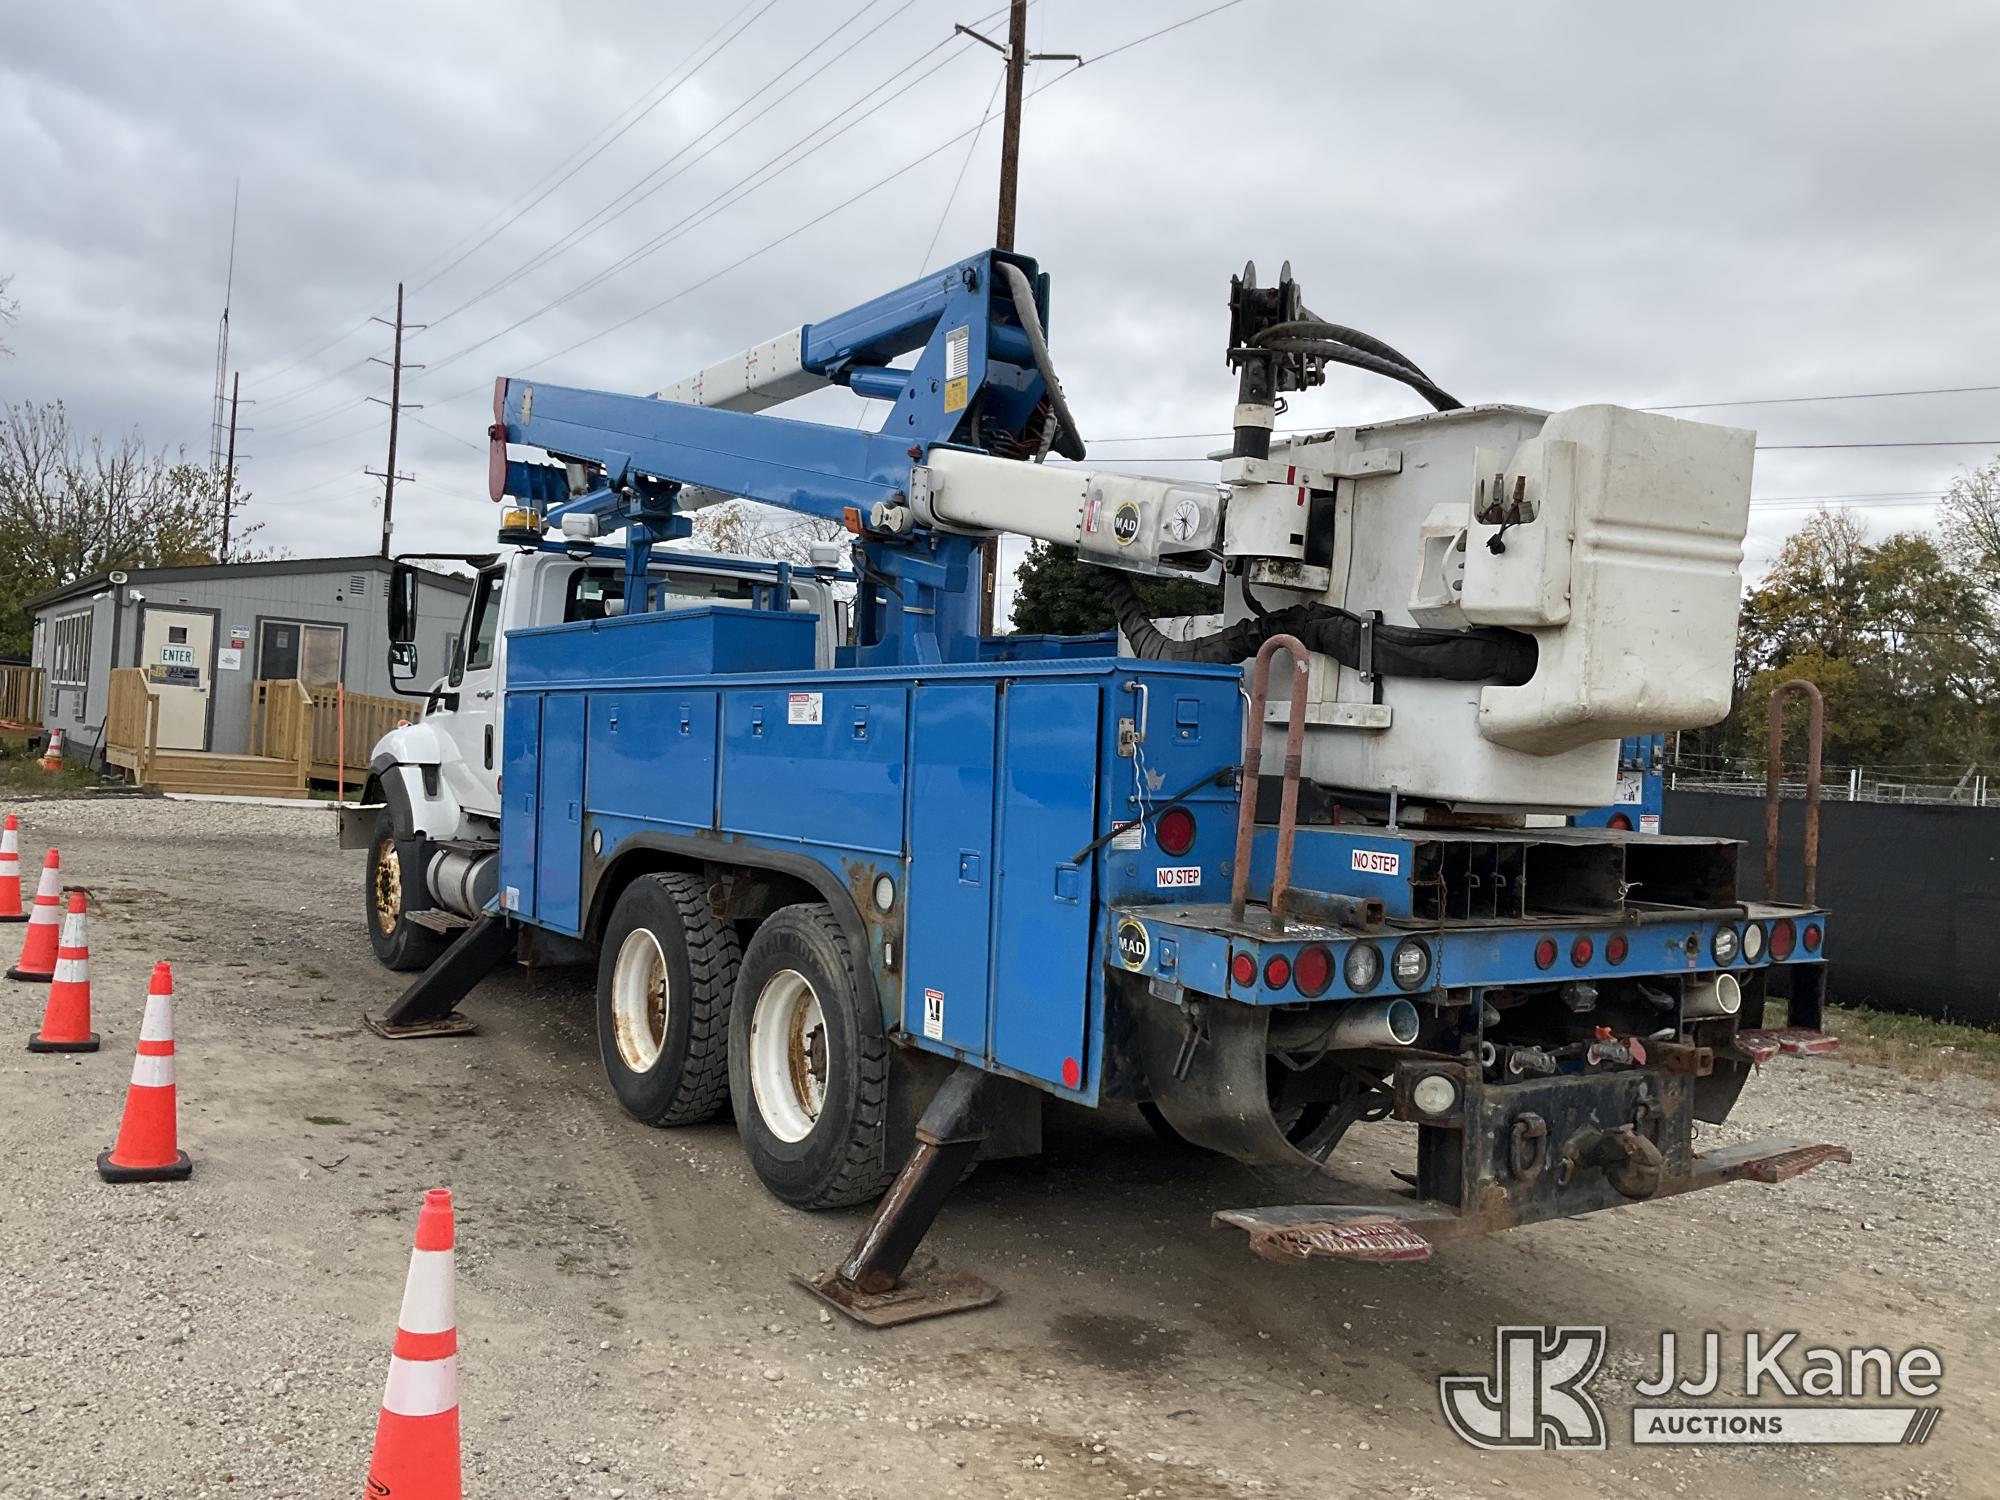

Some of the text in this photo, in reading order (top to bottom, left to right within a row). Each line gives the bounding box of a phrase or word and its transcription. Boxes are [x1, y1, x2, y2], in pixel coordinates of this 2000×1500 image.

[163, 649, 191, 662] ENTER
[1353, 852, 1397, 872] NO STEP
[1158, 869, 1199, 885] NO STEP
